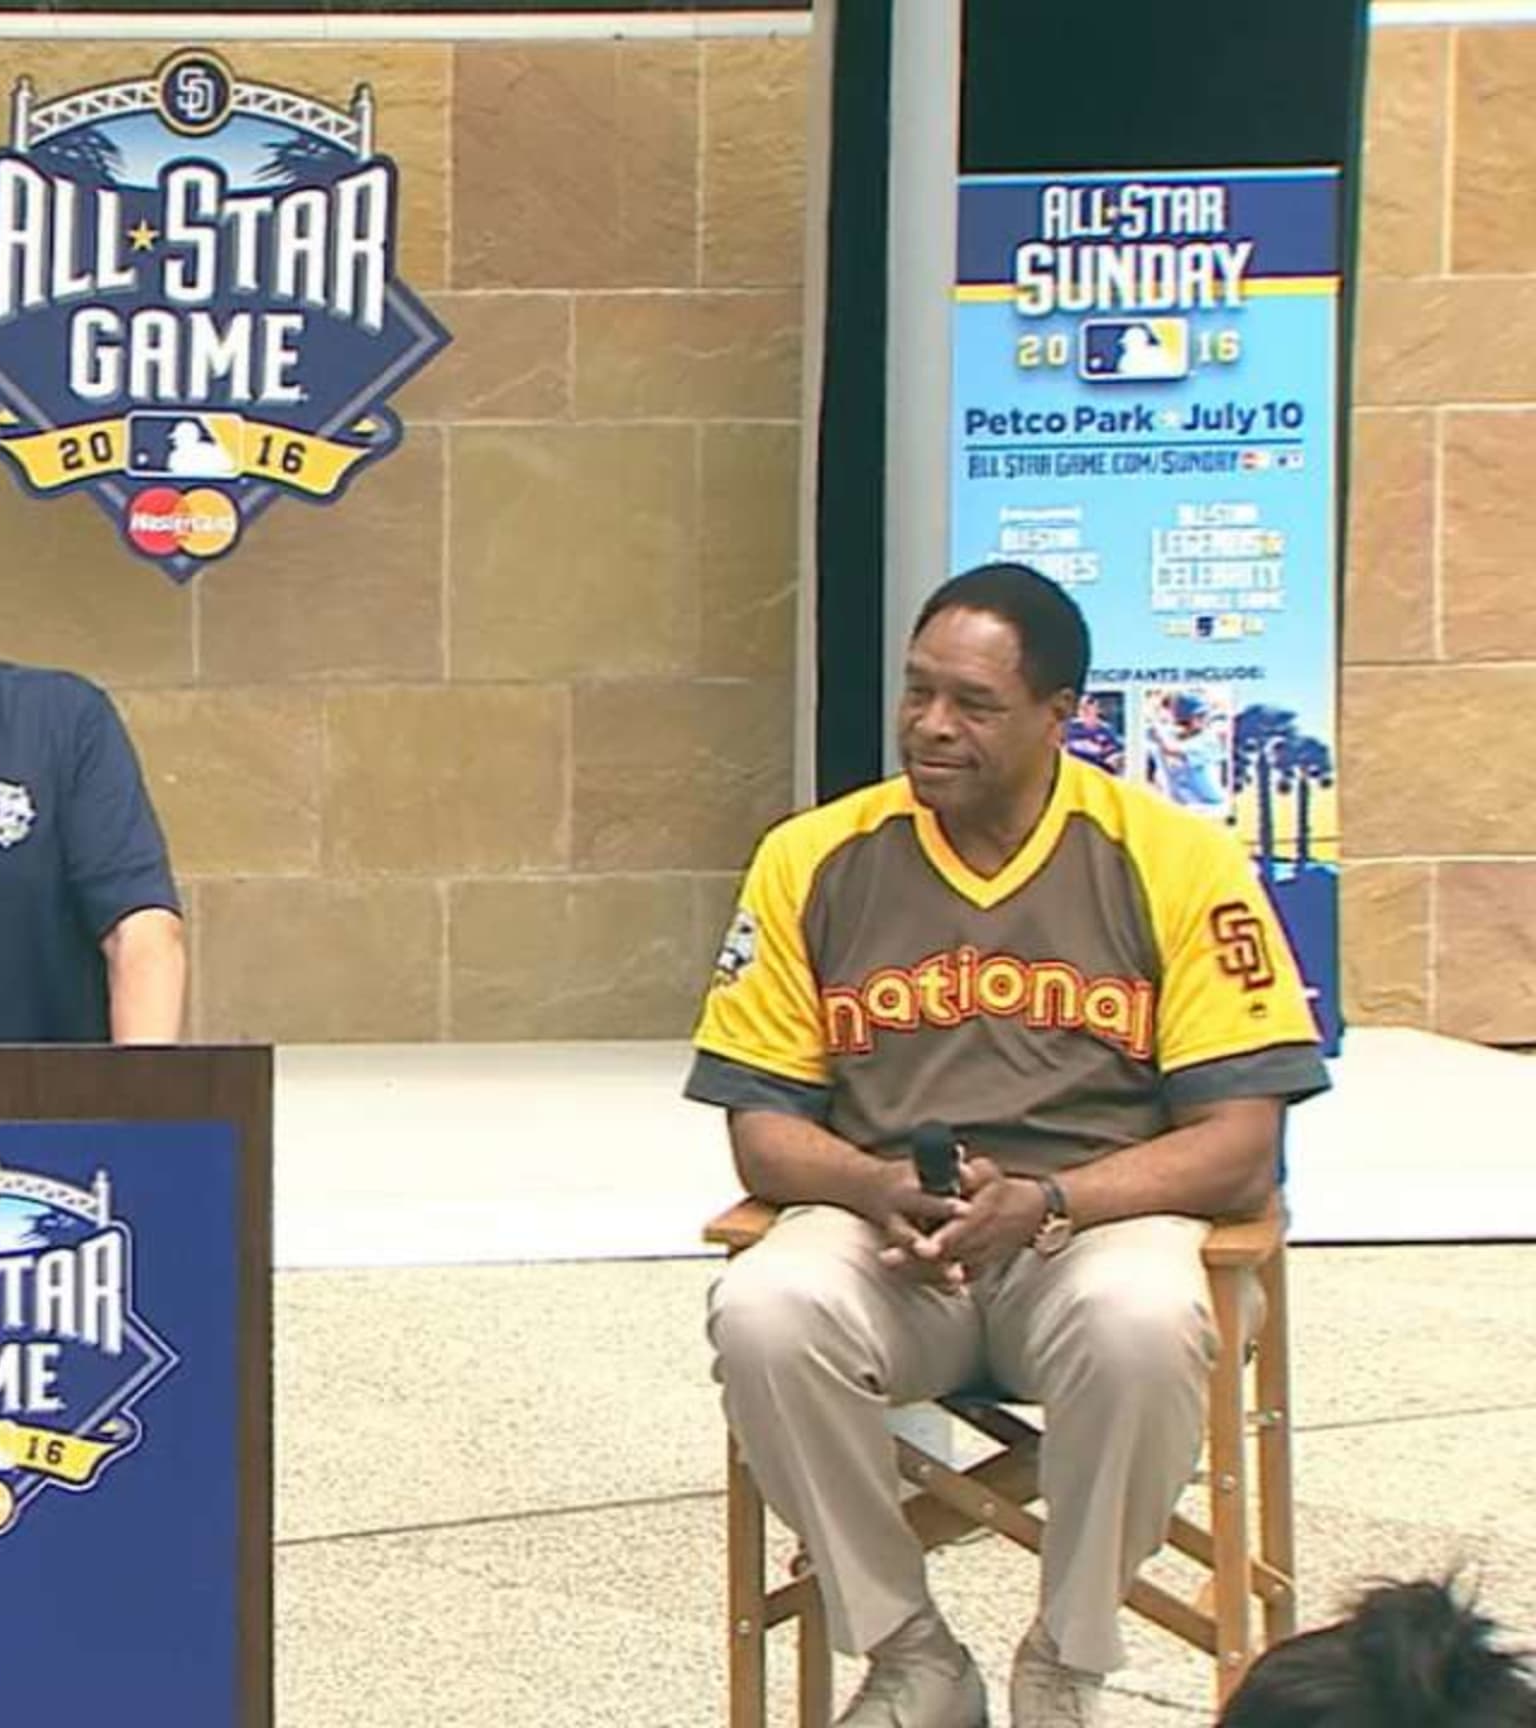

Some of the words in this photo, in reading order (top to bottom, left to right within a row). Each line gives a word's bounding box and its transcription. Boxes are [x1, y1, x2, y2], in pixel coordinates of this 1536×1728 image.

[176, 67, 215, 122] SD
[164, 163, 390, 334] STAR
[1015, 242, 1254, 316] SUNDAY
[70, 307, 305, 403] GAME
[964, 407, 1068, 437] Petco
[1074, 404, 1155, 434] Park
[1180, 402, 1258, 437] July
[1261, 401, 1305, 431] 10
[822, 946, 1158, 1061] national
